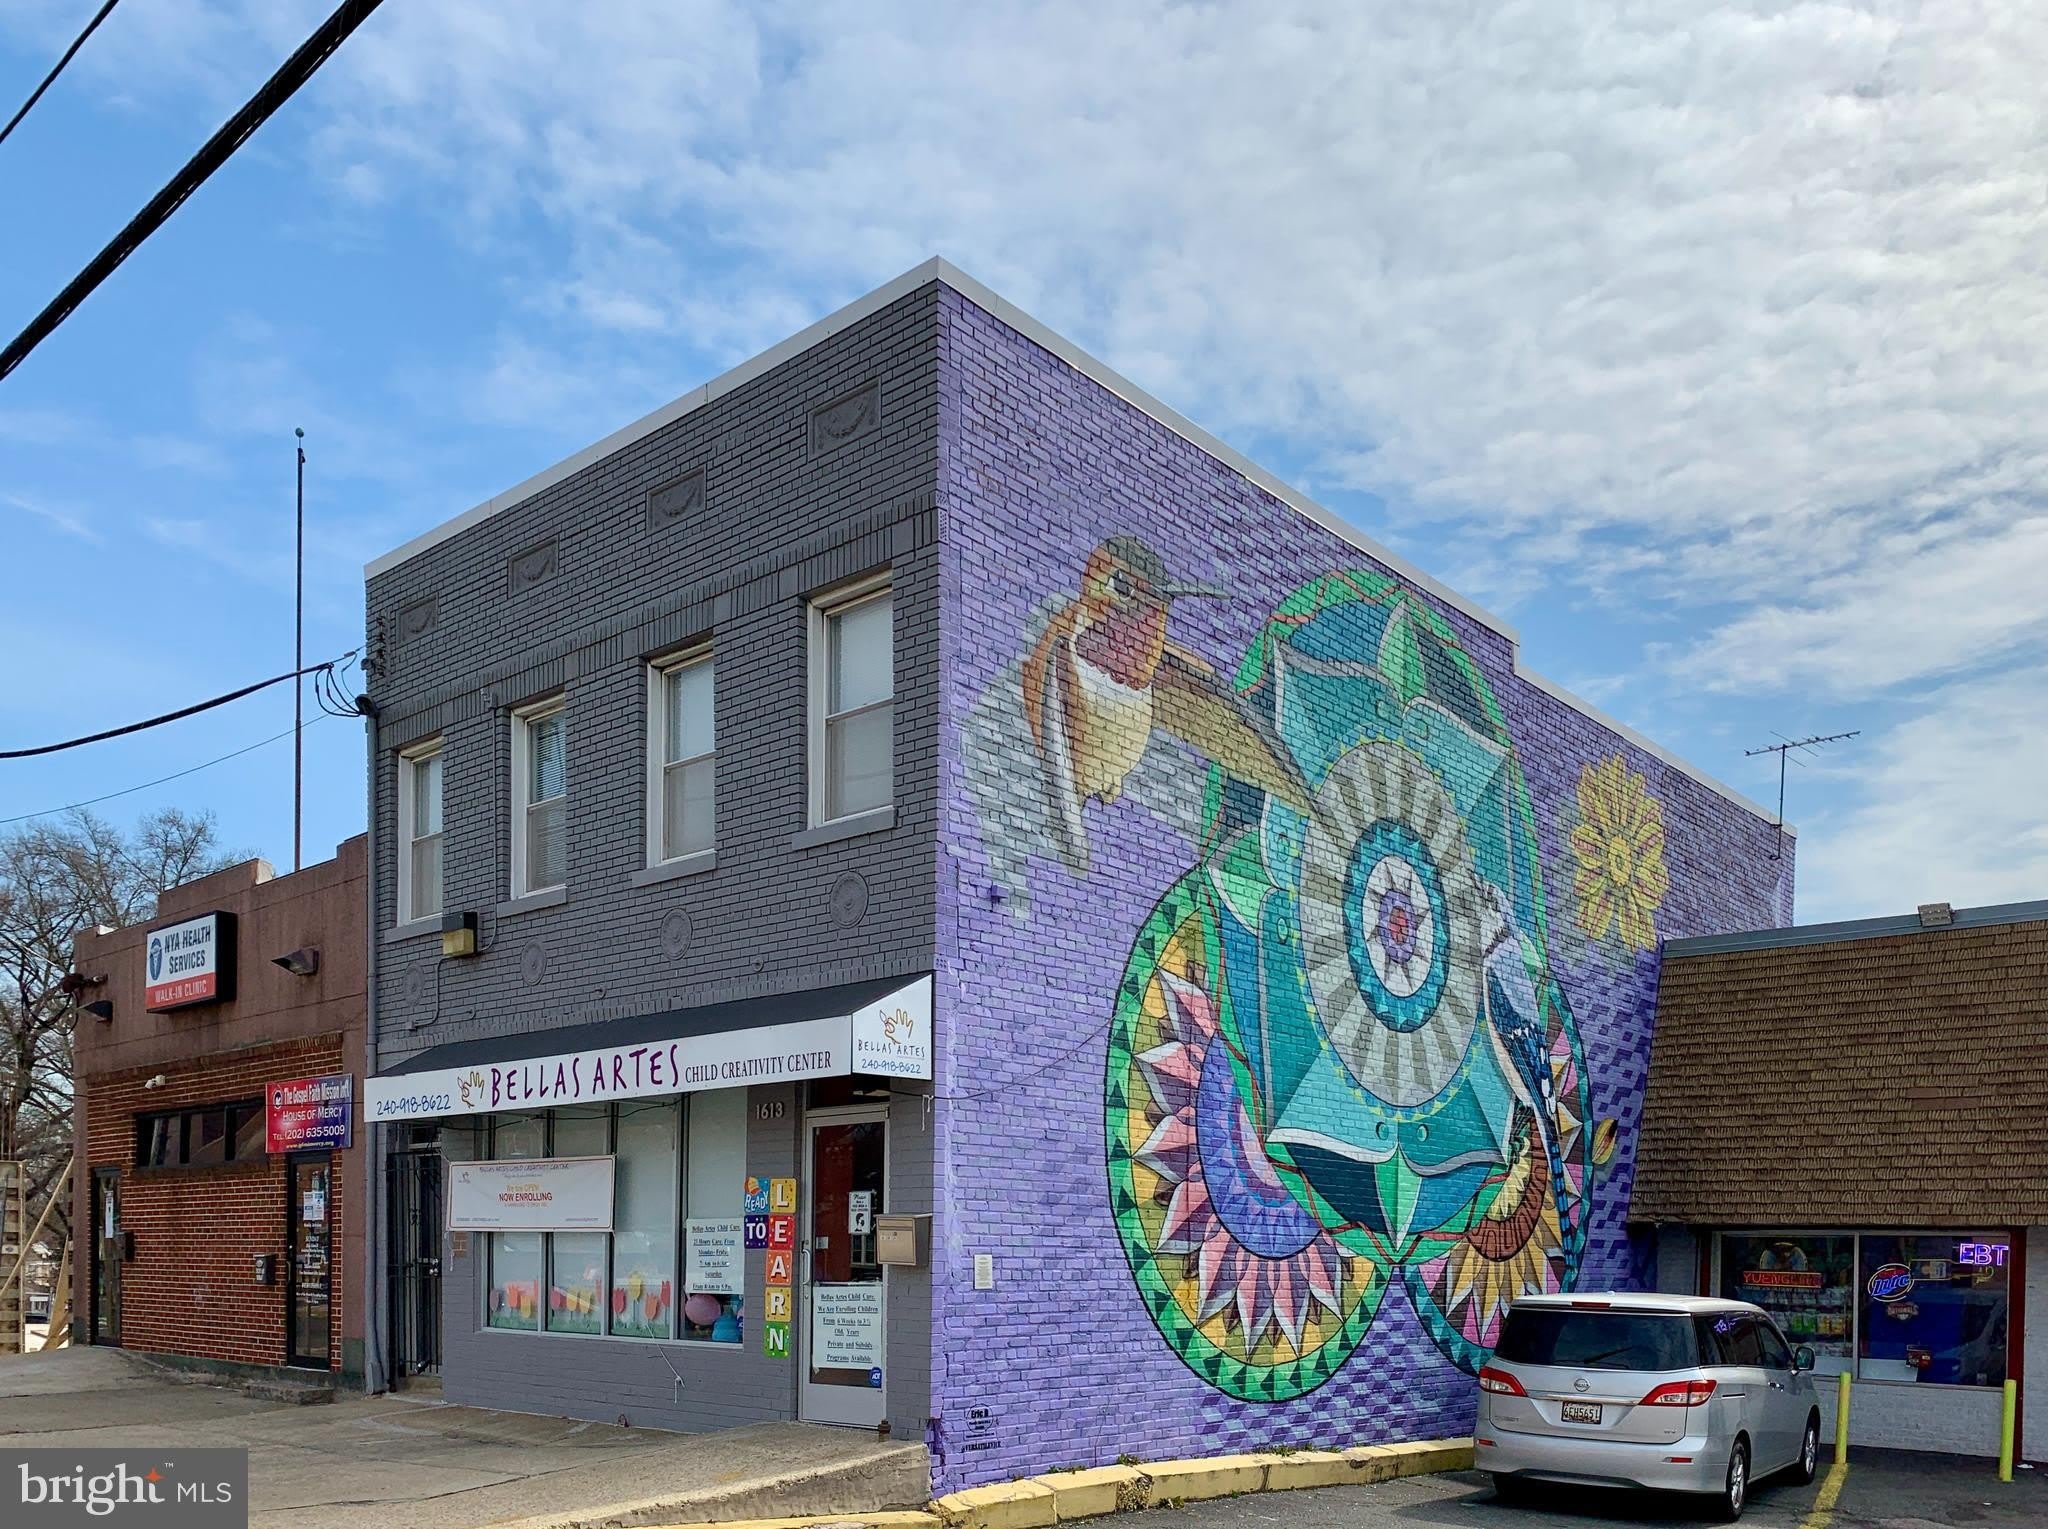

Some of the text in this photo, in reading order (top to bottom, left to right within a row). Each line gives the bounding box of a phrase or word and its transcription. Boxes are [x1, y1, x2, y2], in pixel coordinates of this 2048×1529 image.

[165, 925, 211, 953] NYA HEALTH
[169, 950, 206, 974] SERVICES
[155, 980, 207, 1003] WALK-IN CLINIC
[858, 1039, 925, 1057] BELLAS ARTES
[861, 1059, 922, 1074] 240-918-8622
[376, 1044, 832, 1116] 240-918-8622 BELLAS ARTES CHILD CREATIVITY CENTER
[283, 1087, 293, 1105] The
[293, 1085, 308, 1104] Gospel
[309, 1082, 320, 1102] Faith
[321, 1081, 339, 1100] Mission
[755, 1102, 783, 1120] 1613
[284, 1129, 305, 1140] (202)
[305, 1124, 345, 1138] 635-5009
[499, 1192, 552, 1201] NOW ENROLLING
[745, 1191, 769, 1211] READY
[747, 1222, 766, 1242] TO
[1959, 1243, 2009, 1266] EBT
